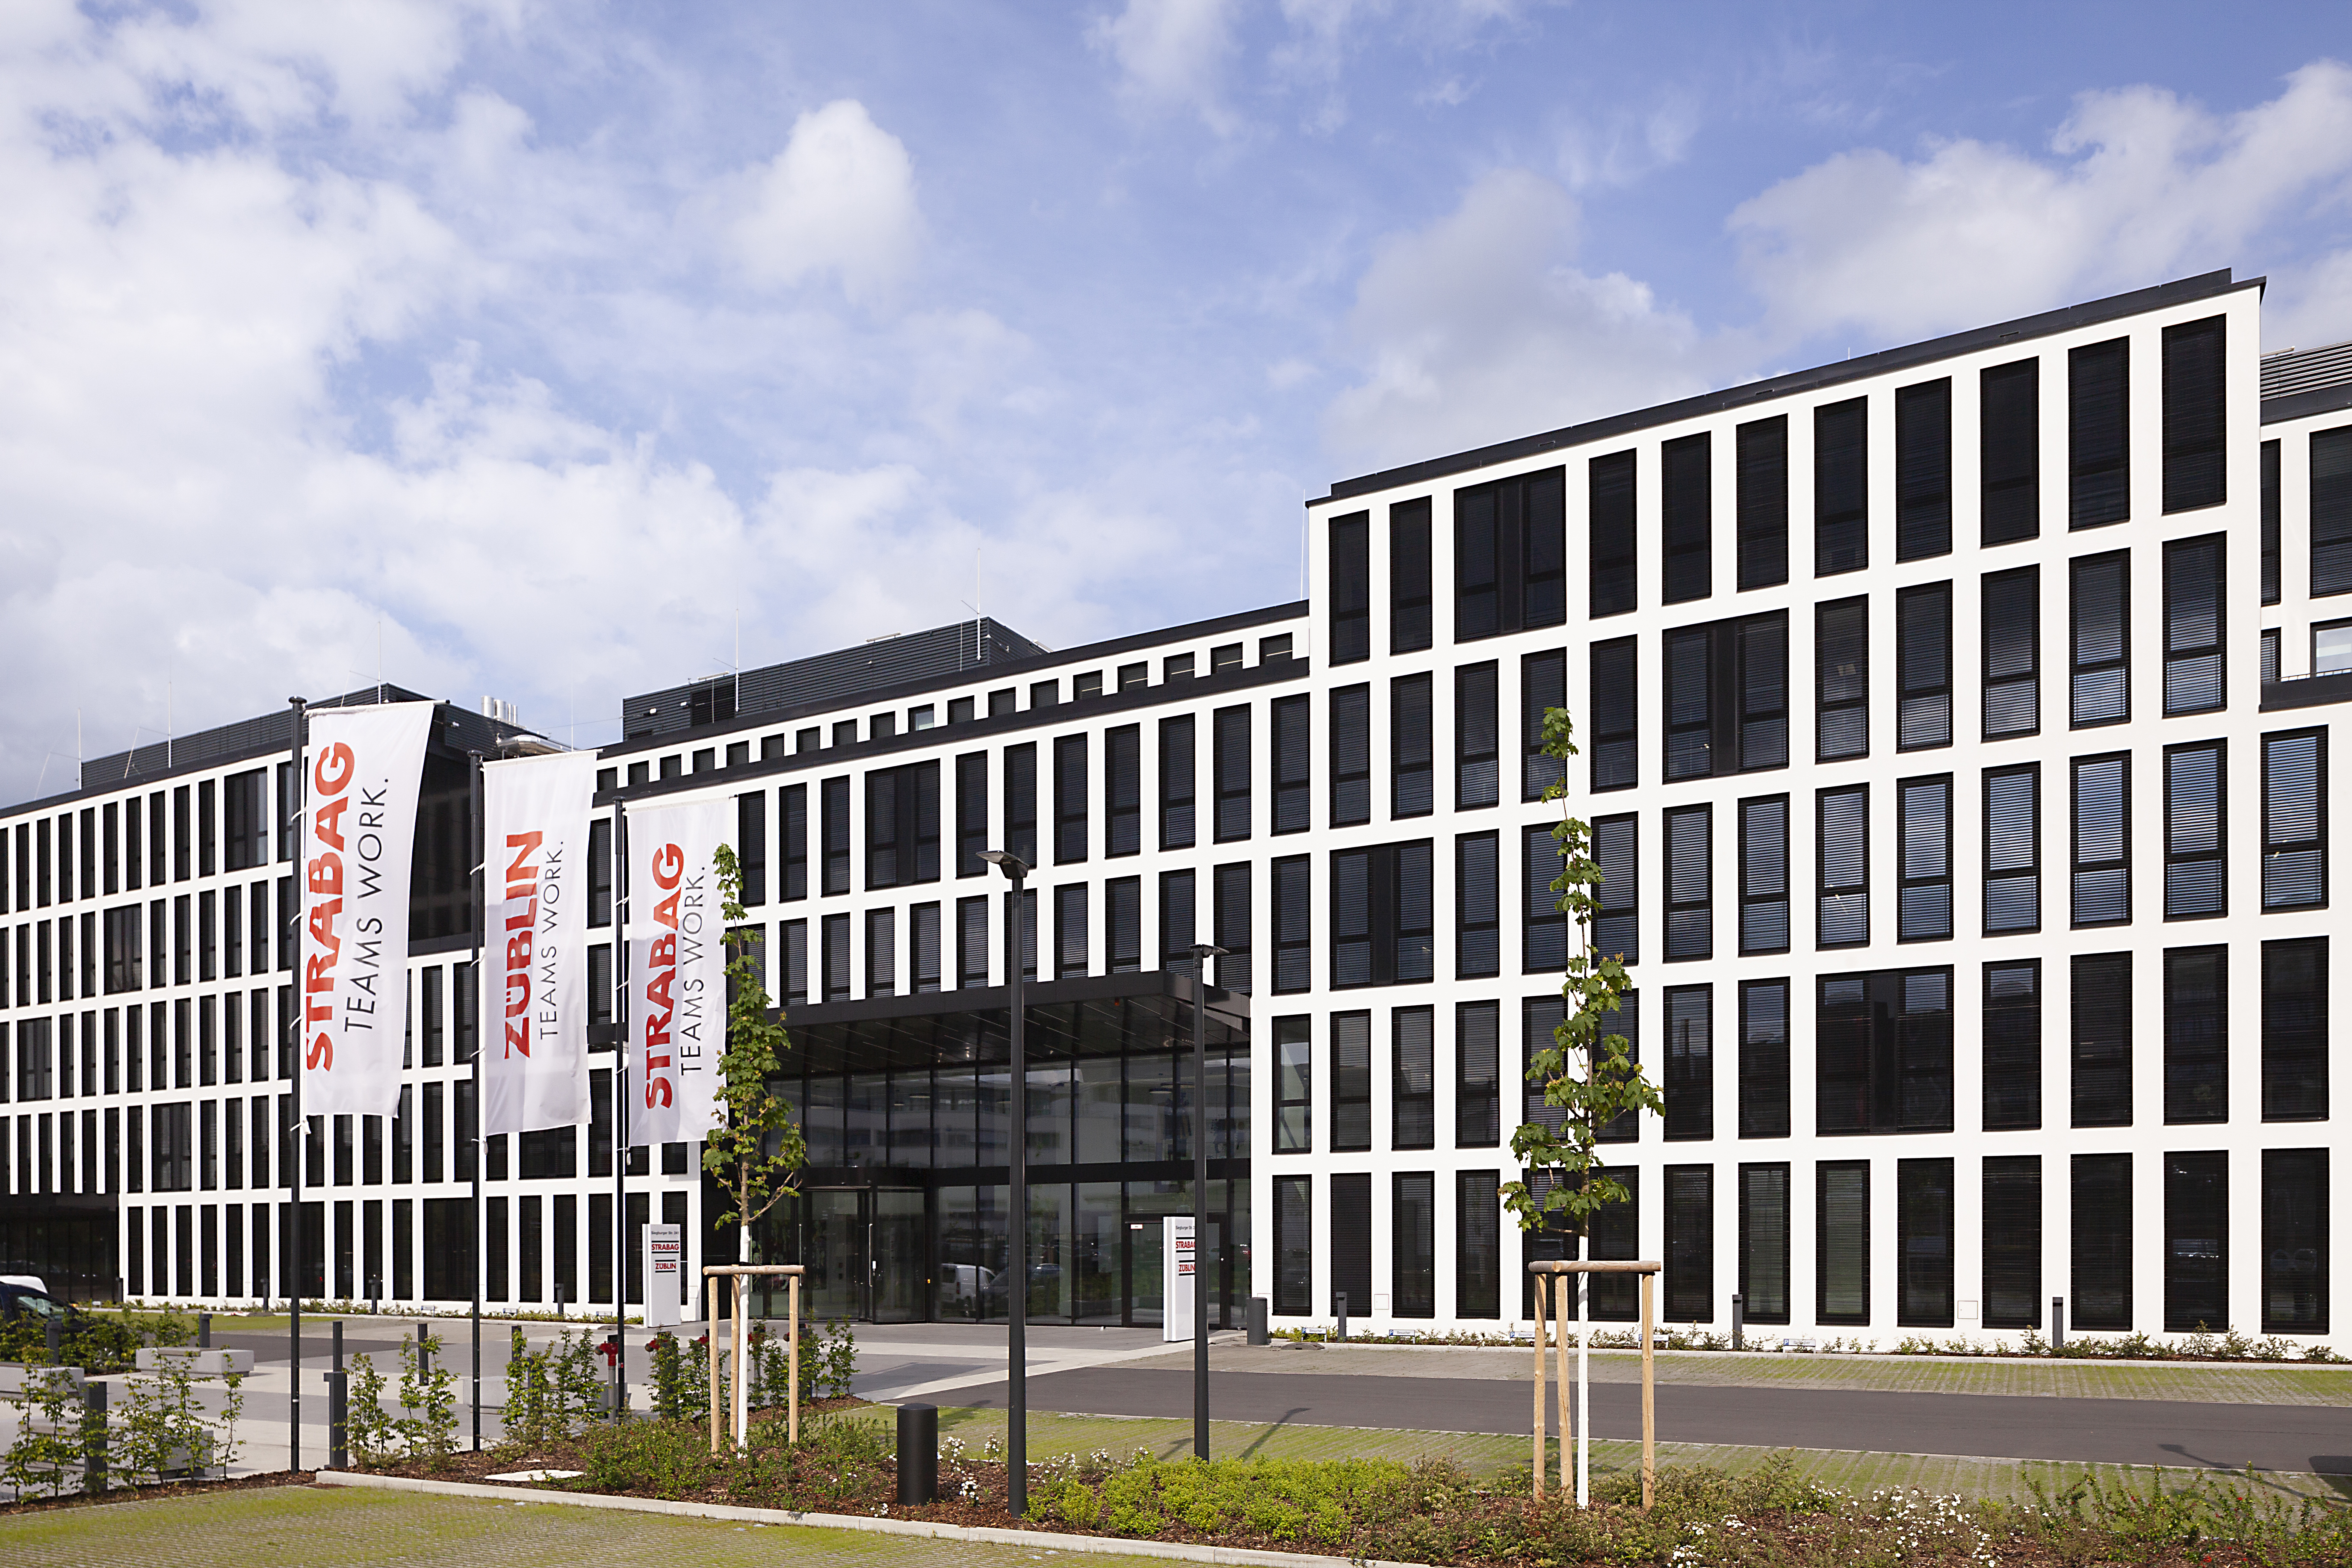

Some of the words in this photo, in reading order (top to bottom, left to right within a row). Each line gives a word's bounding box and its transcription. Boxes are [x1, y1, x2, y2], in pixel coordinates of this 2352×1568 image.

[358, 779, 389, 899] WORK.
[543, 841, 564, 934] WORK.
[306, 742, 355, 1072] STRABAG
[504, 831, 543, 1060] ZÜBLIN
[683, 867, 705, 966] WORK.
[344, 918, 383, 1032] TEAMS
[540, 946, 558, 1040] TEAMS
[645, 843, 684, 1110] STRABAG
[680, 979, 704, 1076] TEAMS
